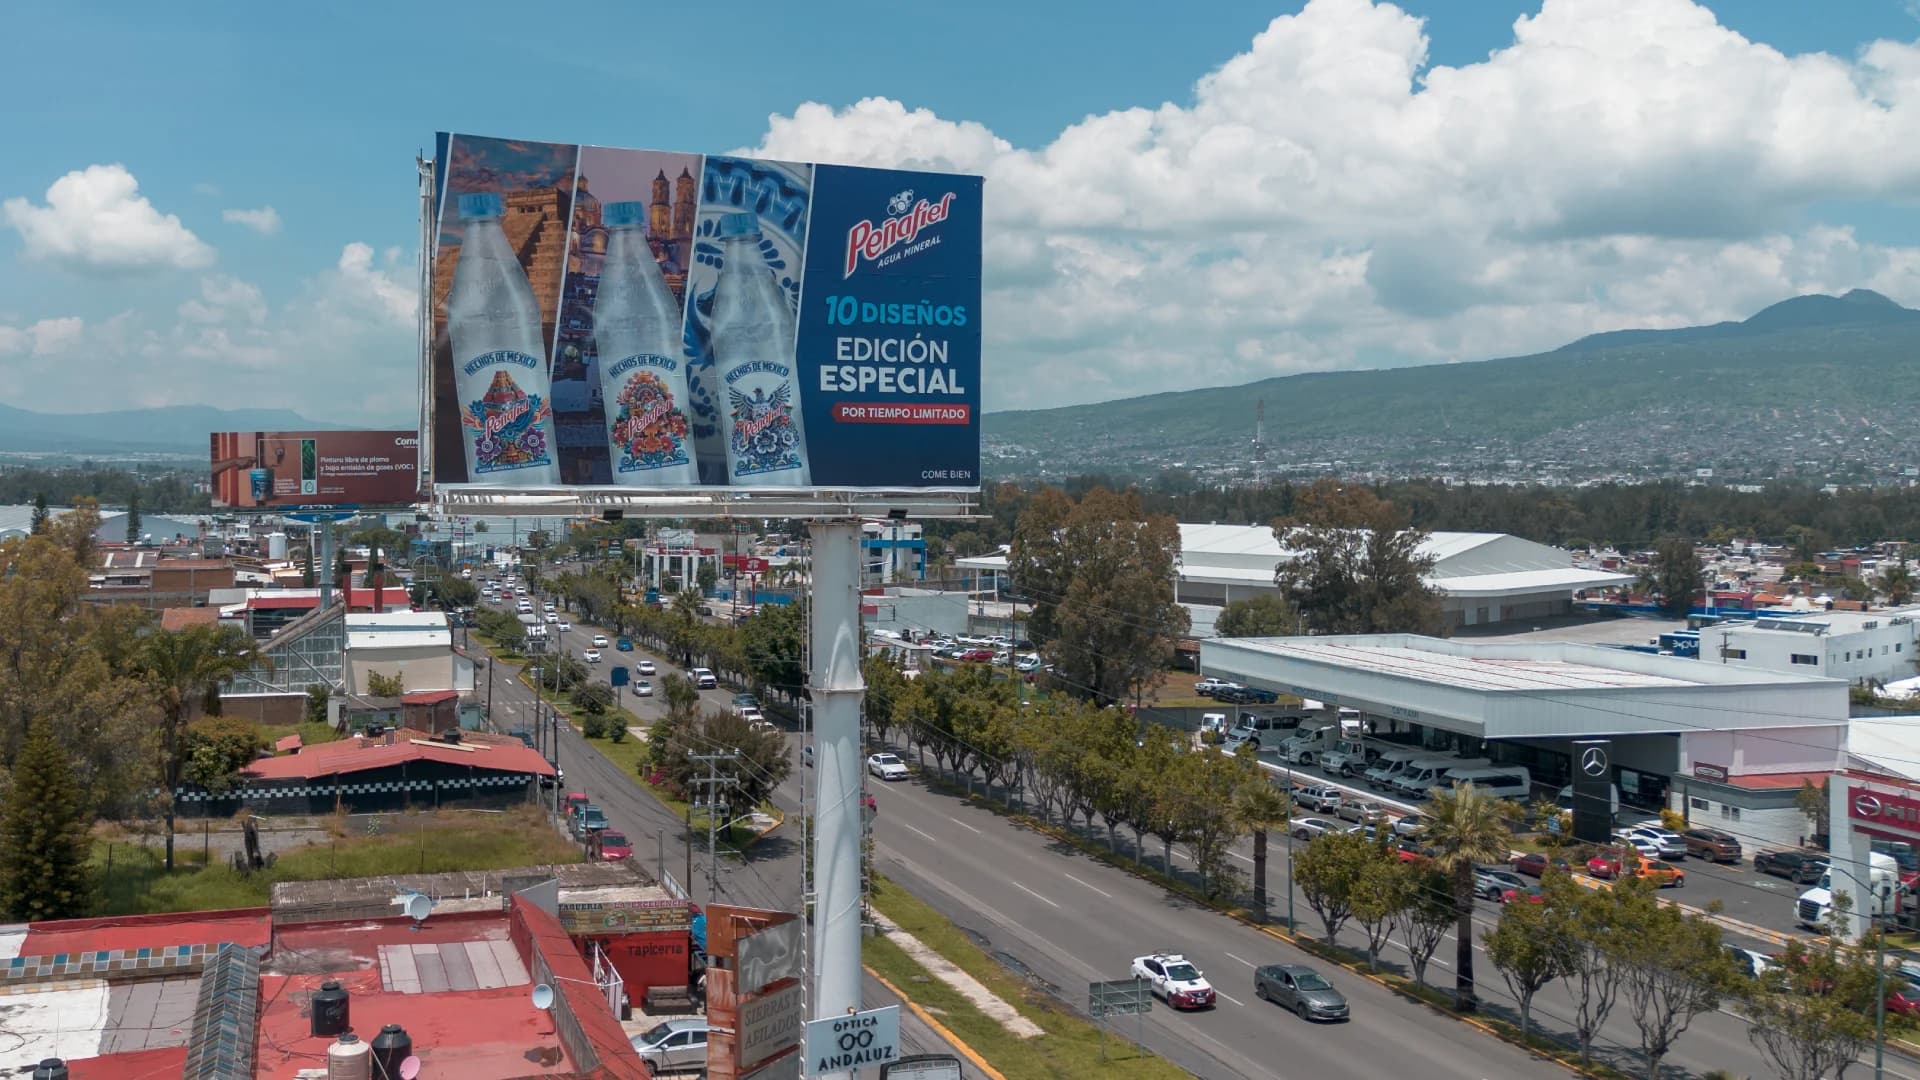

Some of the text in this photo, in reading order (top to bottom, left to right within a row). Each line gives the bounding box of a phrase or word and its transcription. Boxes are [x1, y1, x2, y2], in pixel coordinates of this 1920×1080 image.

[843, 192, 954, 280] Peñafiel
[878, 235, 941, 269] AGUA MINERAL
[825, 296, 967, 327] 10 DISEÑOS
[837, 333, 948, 364] EDICIÓN
[820, 365, 965, 394] ESPECIAL
[842, 407, 966, 419] POR TIEMPO LIMITADO
[369, 456, 390, 464] plomo
[921, 470, 971, 479] COME BIEN
[1885, 803, 1920, 823] HI
[745, 993, 790, 1026] SIERRAS
[834, 1016, 878, 1032] ÓPTICA
[744, 1011, 800, 1050] AFILADOS
